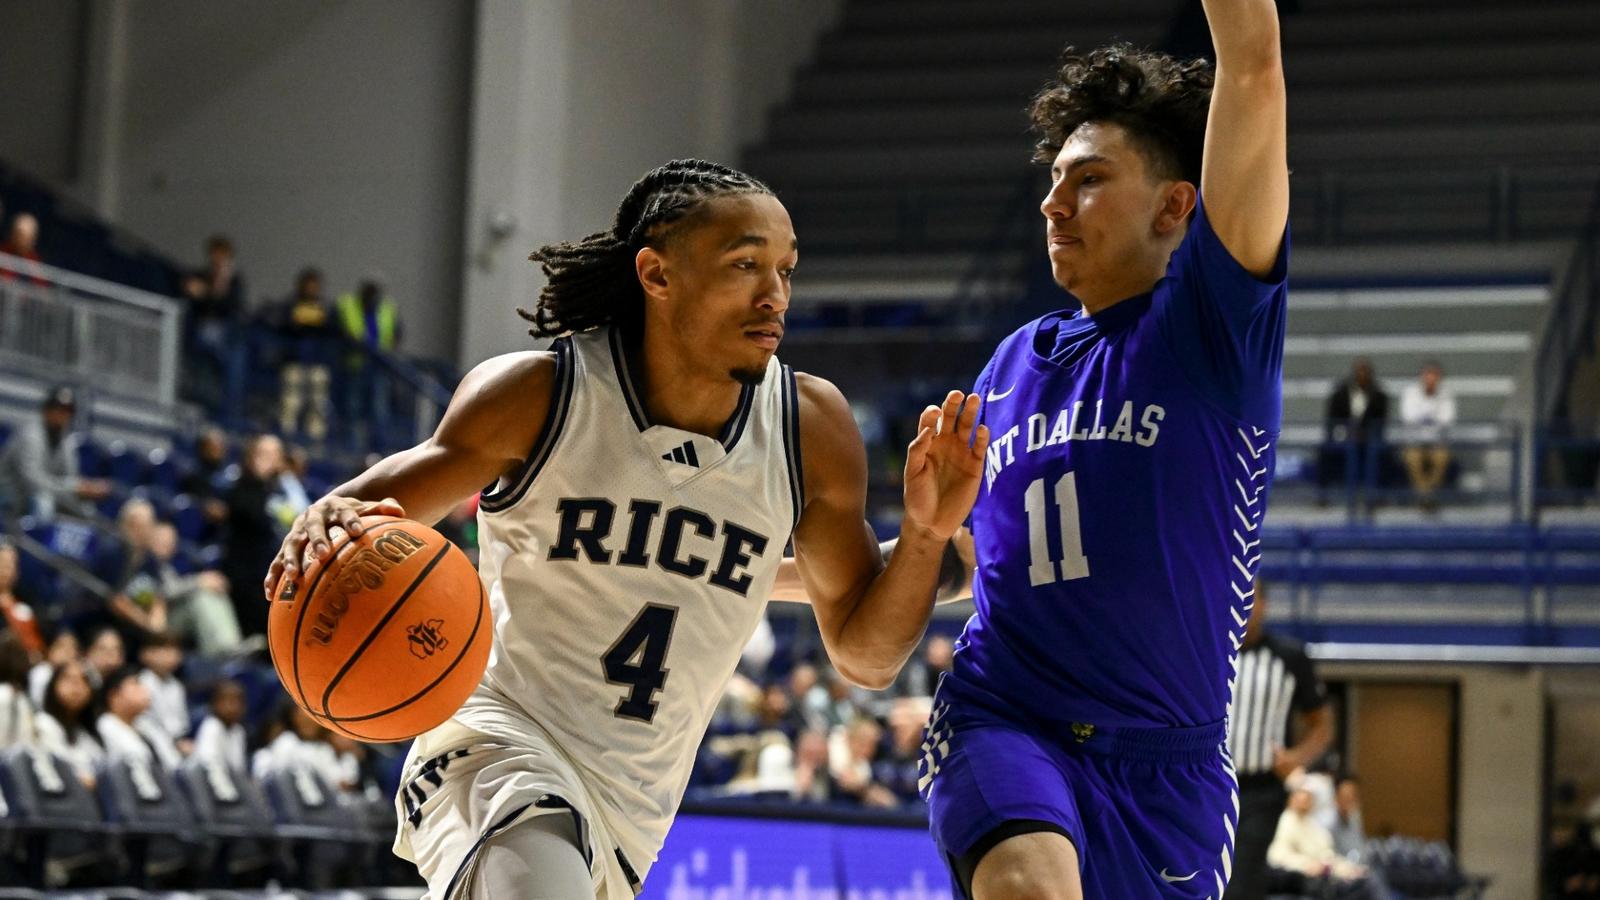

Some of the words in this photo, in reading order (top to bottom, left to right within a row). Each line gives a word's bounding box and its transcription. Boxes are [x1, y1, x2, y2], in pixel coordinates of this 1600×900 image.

[1026, 399, 1166, 454] DALLAS
[546, 497, 770, 598] RICE
[1024, 470, 1090, 587] 11
[305, 528, 428, 647] Wilson
[600, 601, 680, 725] 4
